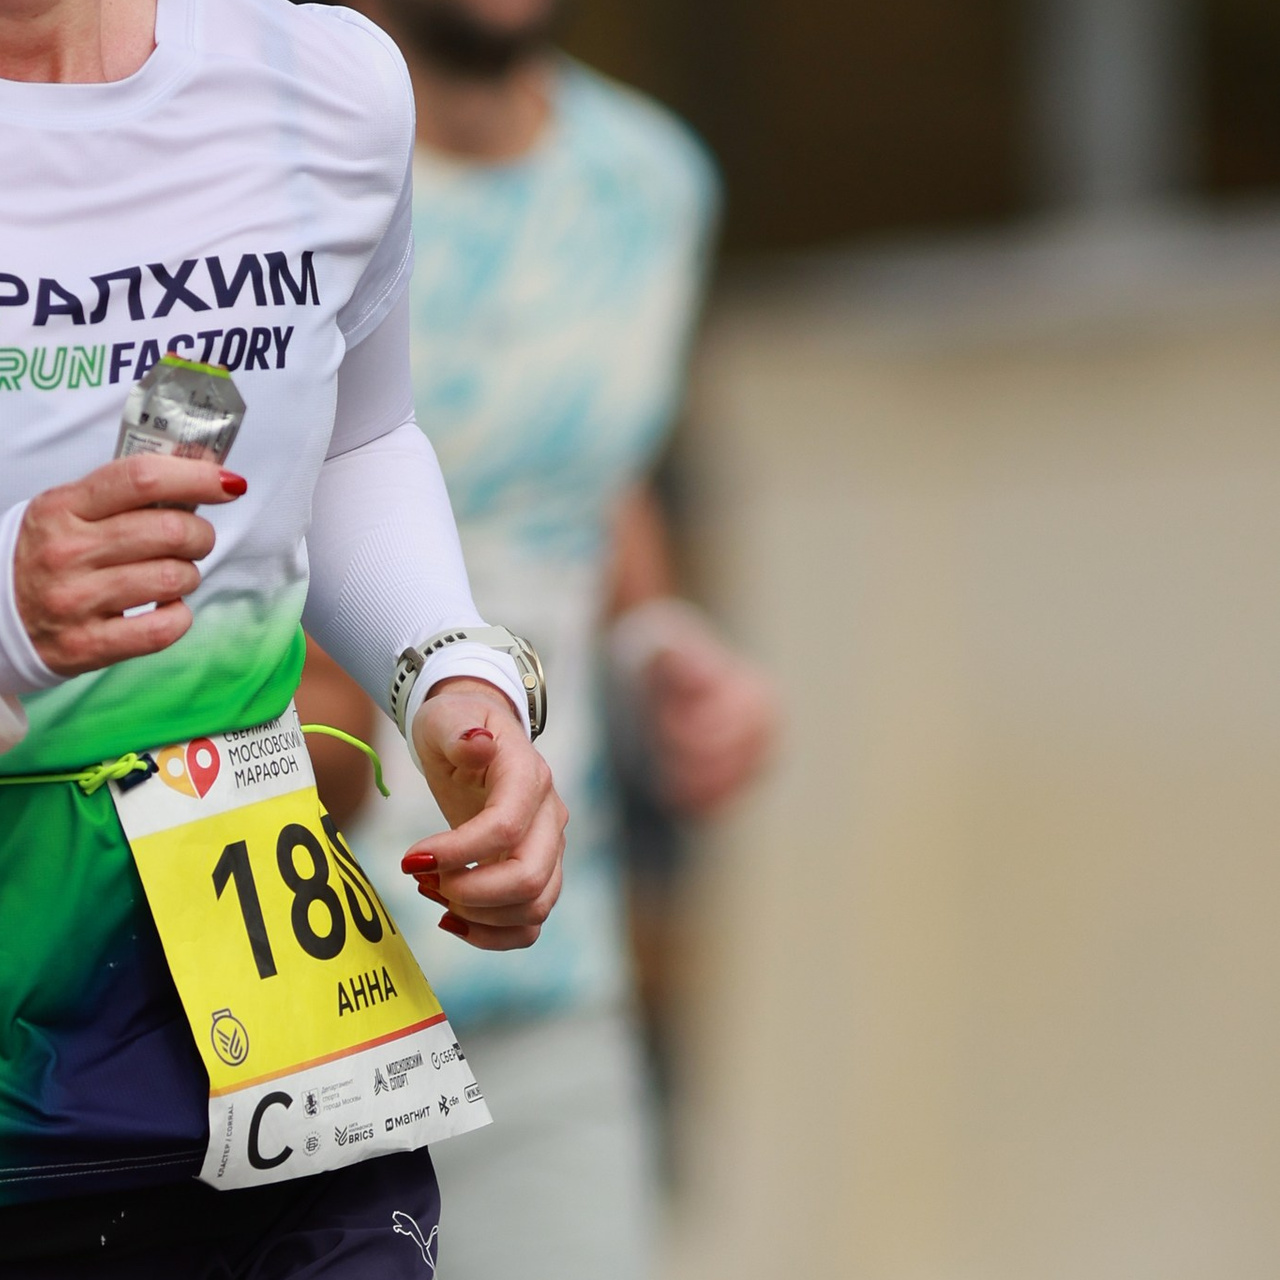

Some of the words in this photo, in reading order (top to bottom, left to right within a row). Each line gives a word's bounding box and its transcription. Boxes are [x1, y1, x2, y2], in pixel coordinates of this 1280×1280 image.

[234, 754, 299, 789] МАРАФОН
[338, 965, 398, 1017] АННА
[348, 1128, 374, 1144] BRICS
